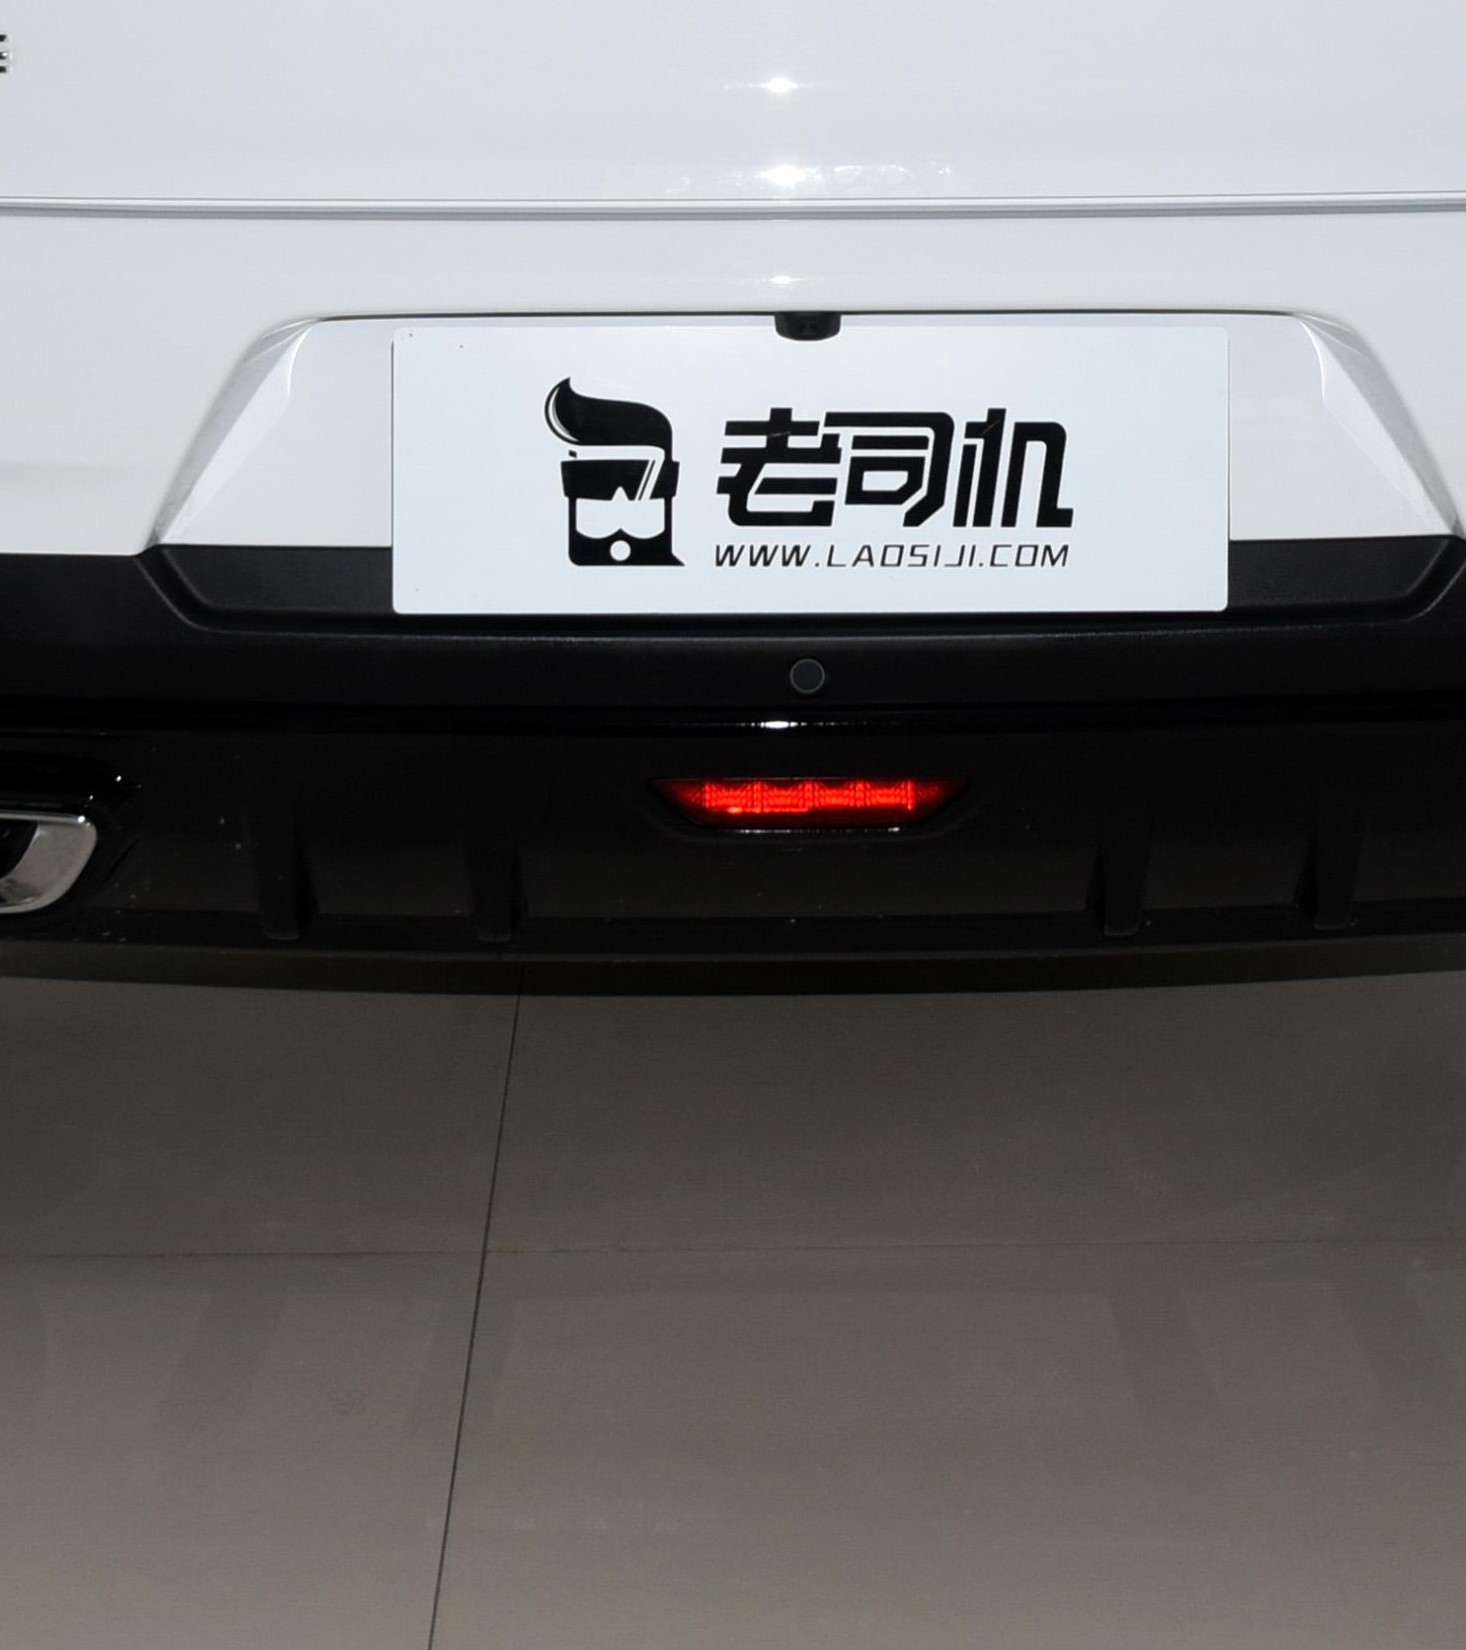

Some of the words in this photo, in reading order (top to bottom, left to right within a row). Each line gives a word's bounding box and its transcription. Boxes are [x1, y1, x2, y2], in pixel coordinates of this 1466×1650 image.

[715, 406, 1075, 529] 老司机
[714, 542, 1070, 569] WWW.LAOSIJI.COM
